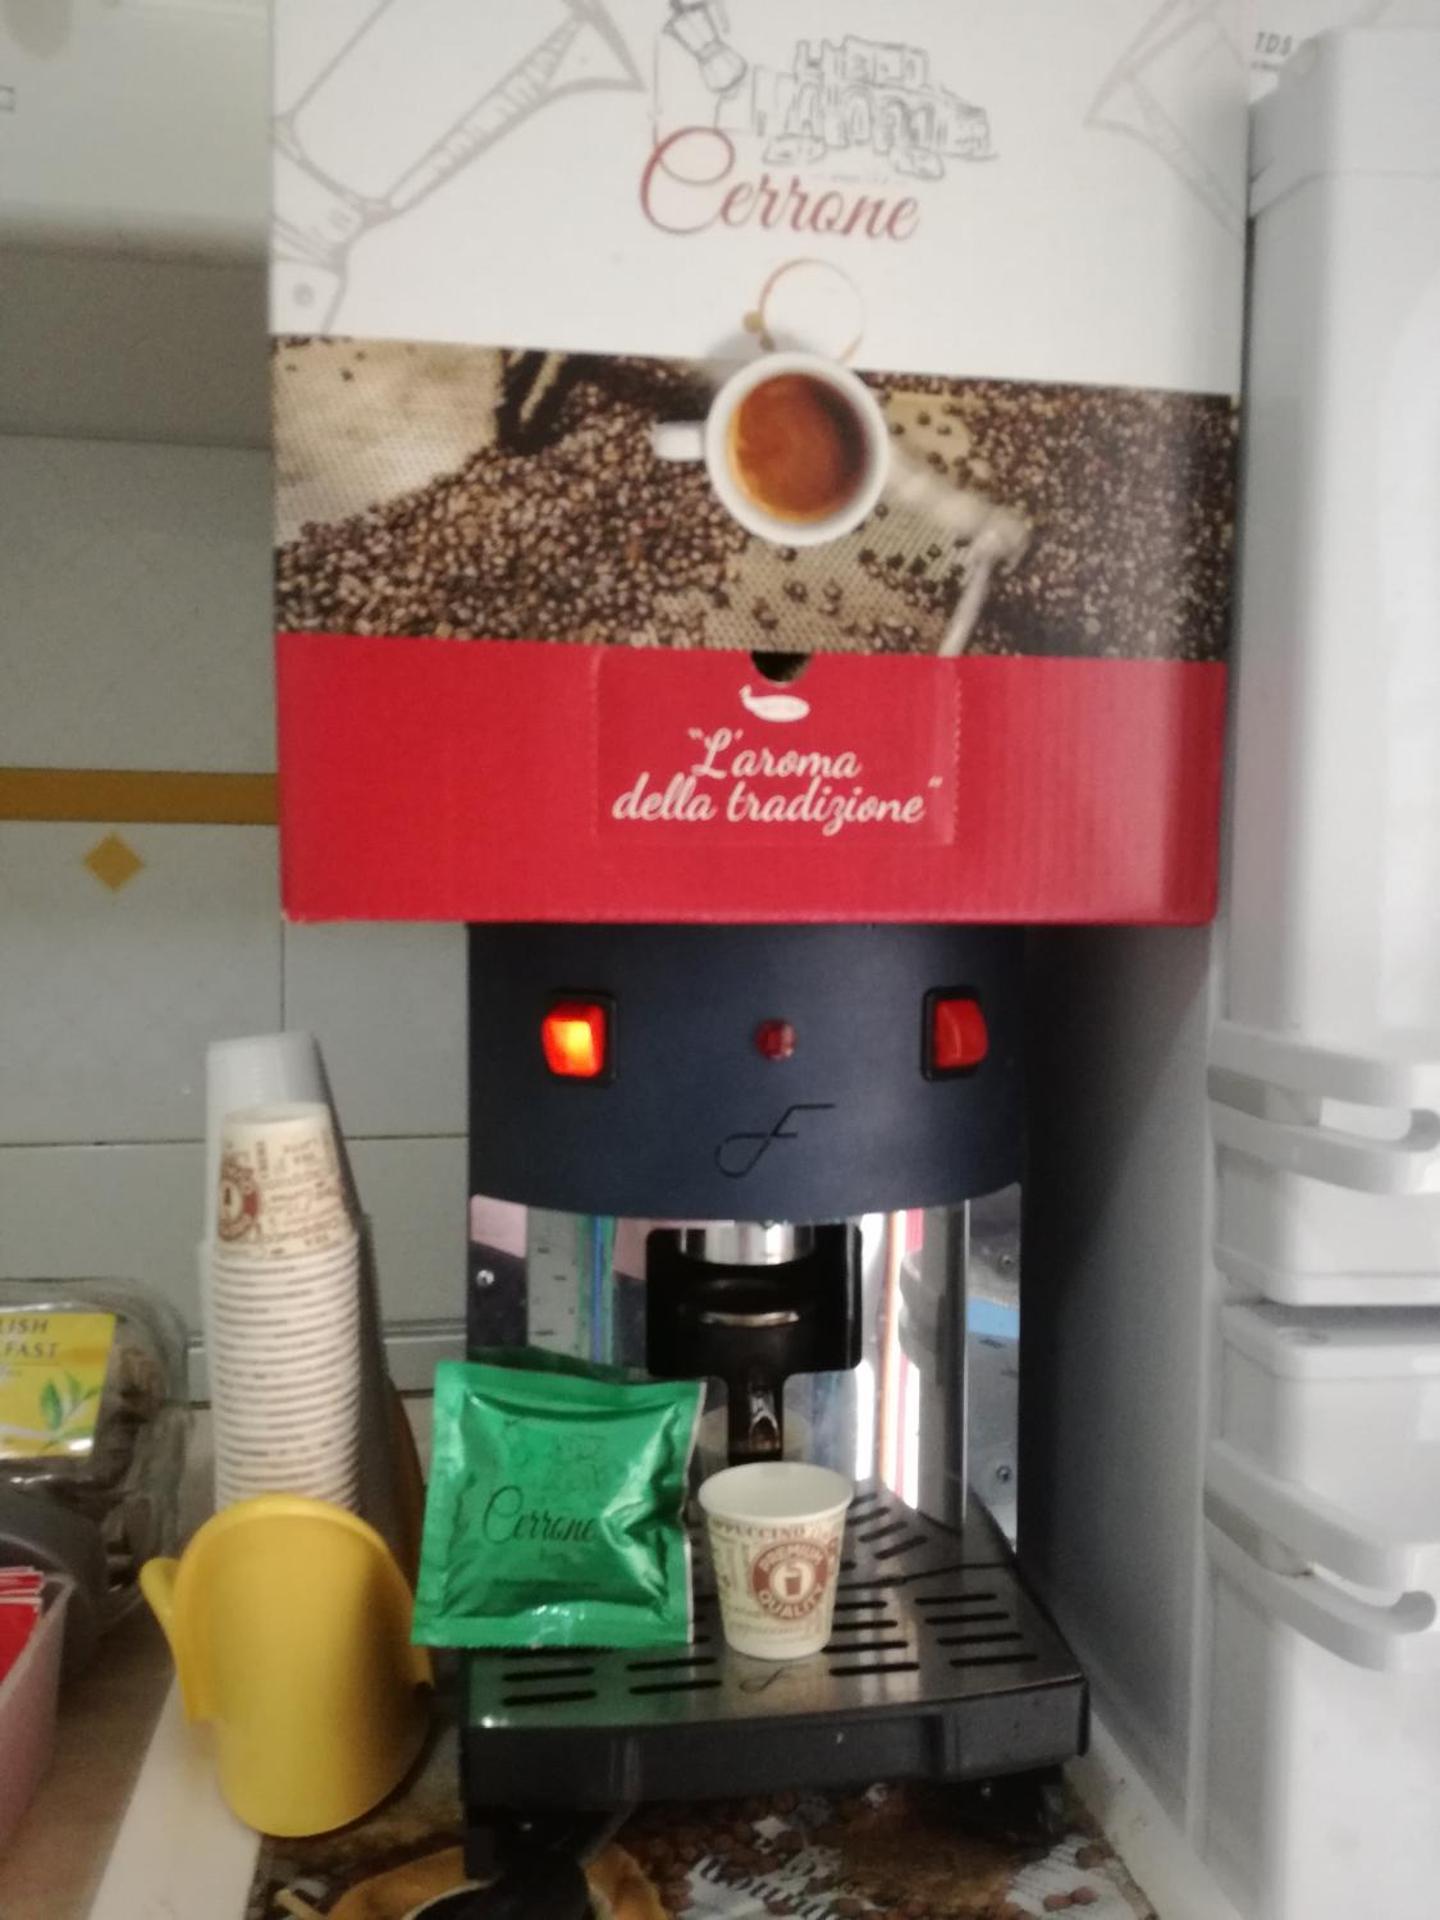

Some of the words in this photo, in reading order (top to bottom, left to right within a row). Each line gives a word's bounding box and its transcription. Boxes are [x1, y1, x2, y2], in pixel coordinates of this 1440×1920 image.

[640, 125, 920, 240] Cerrone
[611, 771, 716, 821] della
[481, 1484, 596, 1545] Cerrone
